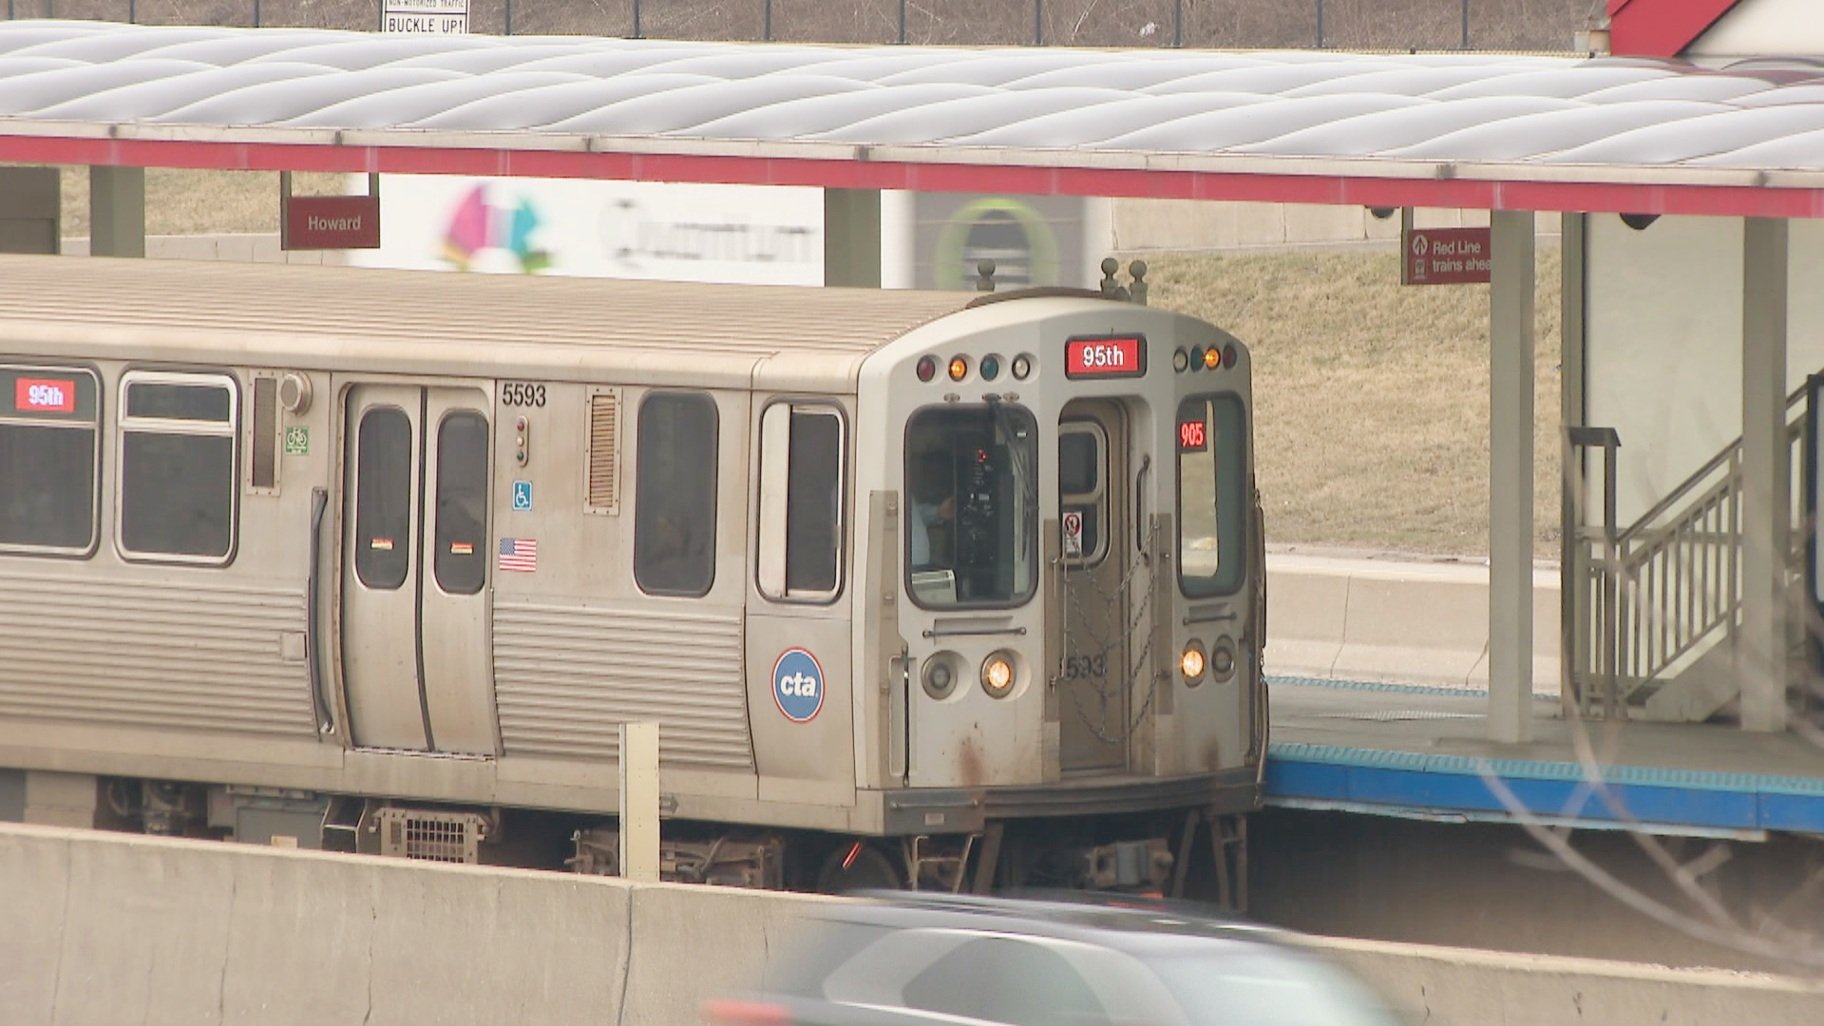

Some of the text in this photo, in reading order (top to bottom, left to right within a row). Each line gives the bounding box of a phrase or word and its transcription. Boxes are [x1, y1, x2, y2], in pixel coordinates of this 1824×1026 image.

[389, 18, 463, 34] BUCKLE UP!
[308, 215, 361, 231] Howard
[1433, 240, 1481, 255] Red Line
[1432, 258, 1463, 272] trains
[1083, 344, 1124, 367] 95th
[28, 384, 64, 406] 95th
[502, 383, 546, 407] 5593
[1181, 423, 1204, 447] 905
[1059, 654, 1105, 679] 593
[780, 672, 817, 697] cta
